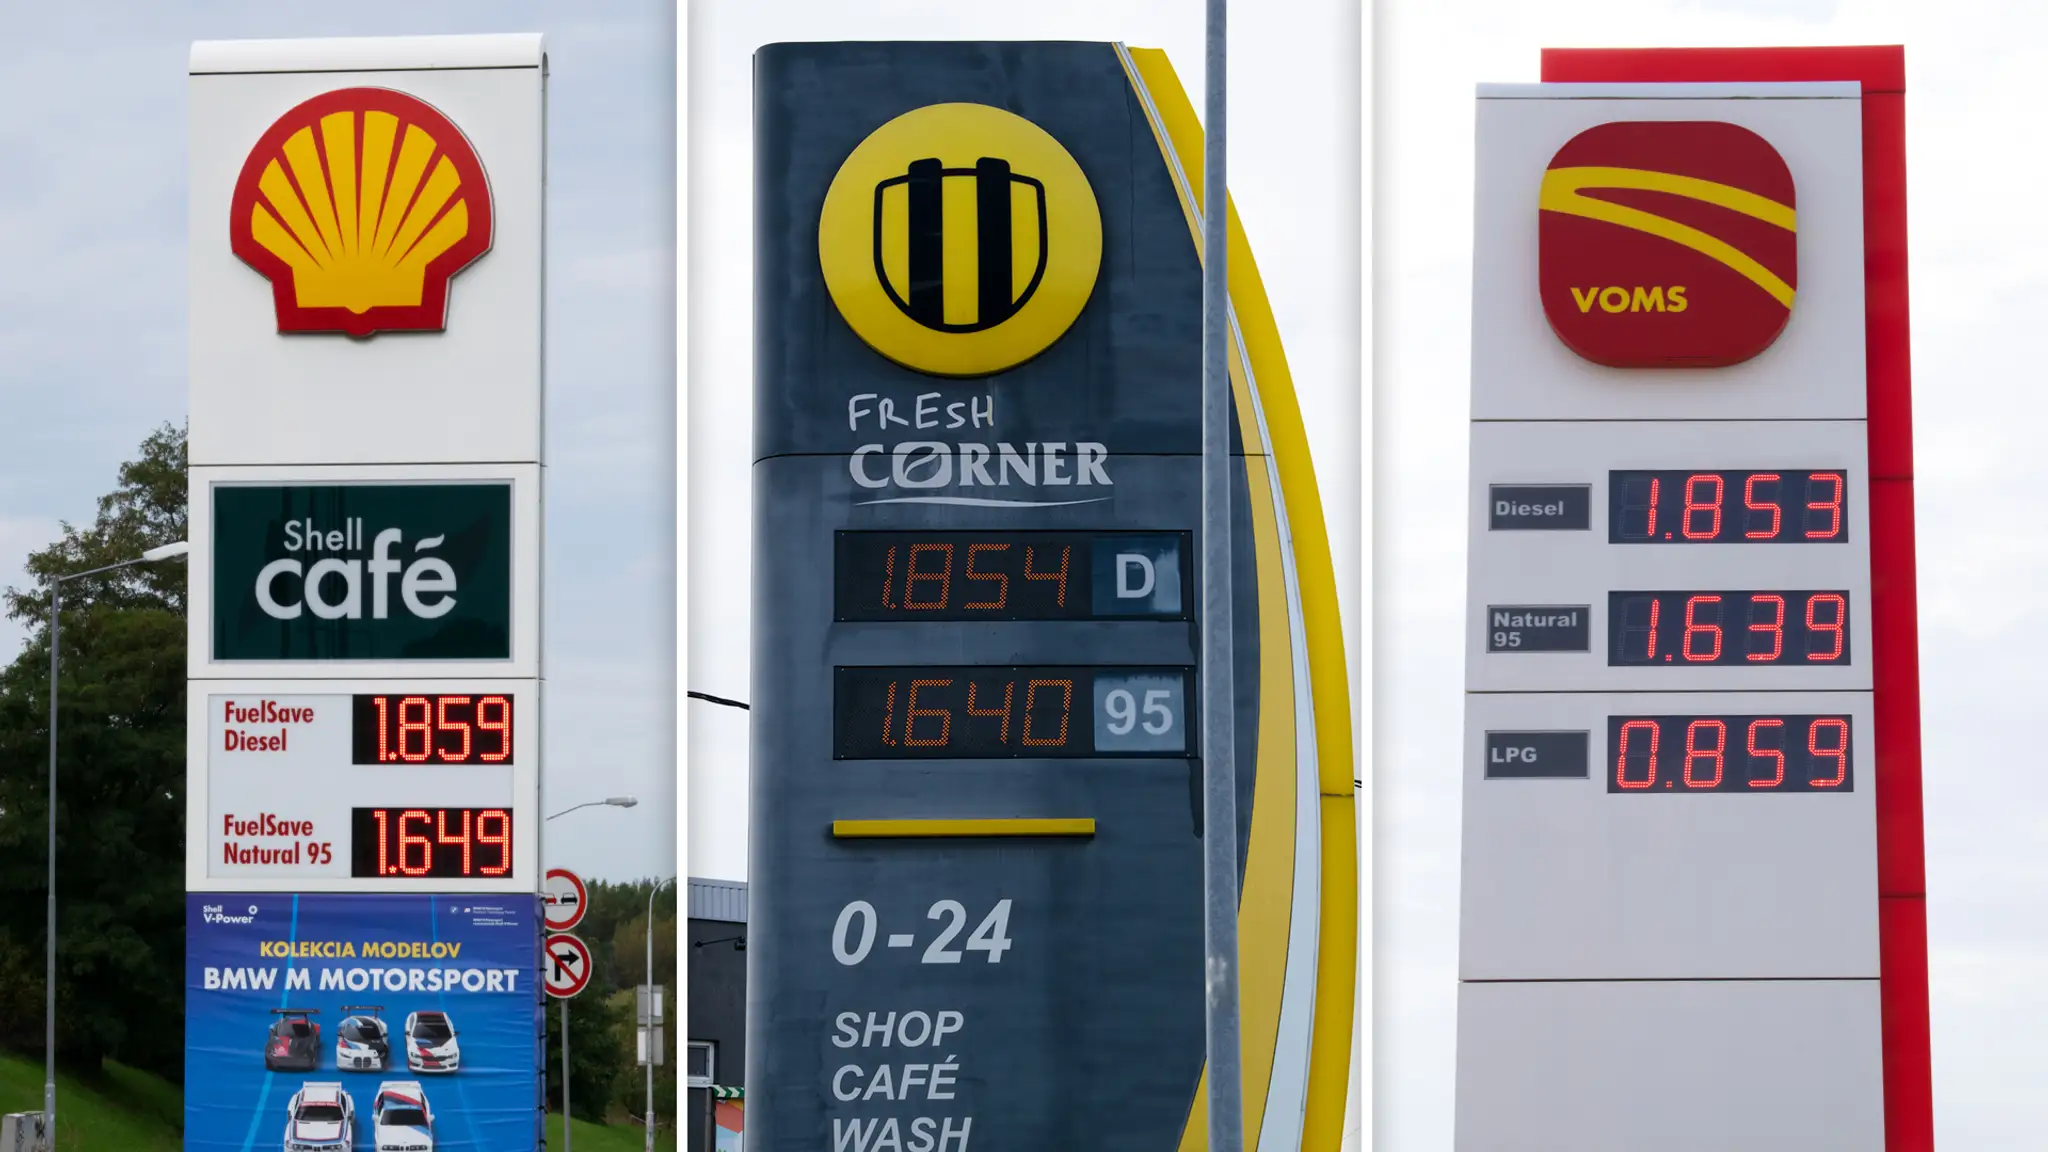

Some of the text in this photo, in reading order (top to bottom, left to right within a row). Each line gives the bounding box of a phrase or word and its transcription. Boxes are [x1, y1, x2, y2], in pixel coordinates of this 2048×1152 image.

[1570, 285, 1688, 313] VOMS
[849, 441, 1114, 489] CORNER
[1495, 500, 1564, 517] Diesel
[1647, 474, 1843, 540] 1.853
[283, 517, 362, 551] Shell
[255, 527, 457, 620] café
[881, 543, 1071, 611] 1.854
[1115, 553, 1156, 599] D
[1494, 611, 1578, 628] Natural
[1647, 594, 1845, 662] 1.639
[1494, 631, 1522, 648] 95
[224, 700, 315, 724] FuelSave
[373, 697, 511, 762] 1.859
[881, 679, 1073, 747] 1.640
[1105, 689, 1174, 736] 95
[224, 728, 288, 752] Diesel
[1491, 747, 1538, 764] LPG
[1616, 719, 1848, 788] 0.859
[223, 813, 314, 837] FuelSave
[223, 841, 333, 865] Natural 95
[373, 810, 511, 876] 1.649
[203, 905, 223, 913] Shell
[203, 913, 255, 924] V-Power
[260, 941, 462, 959] KOLEKCIA MODELOV
[203, 967, 520, 992] BMW M MOTORSPORT
[831, 1010, 965, 1049] SHOP
[831, 1055, 960, 1102] CAFÉ
[832, 1116, 973, 1152] WASH
